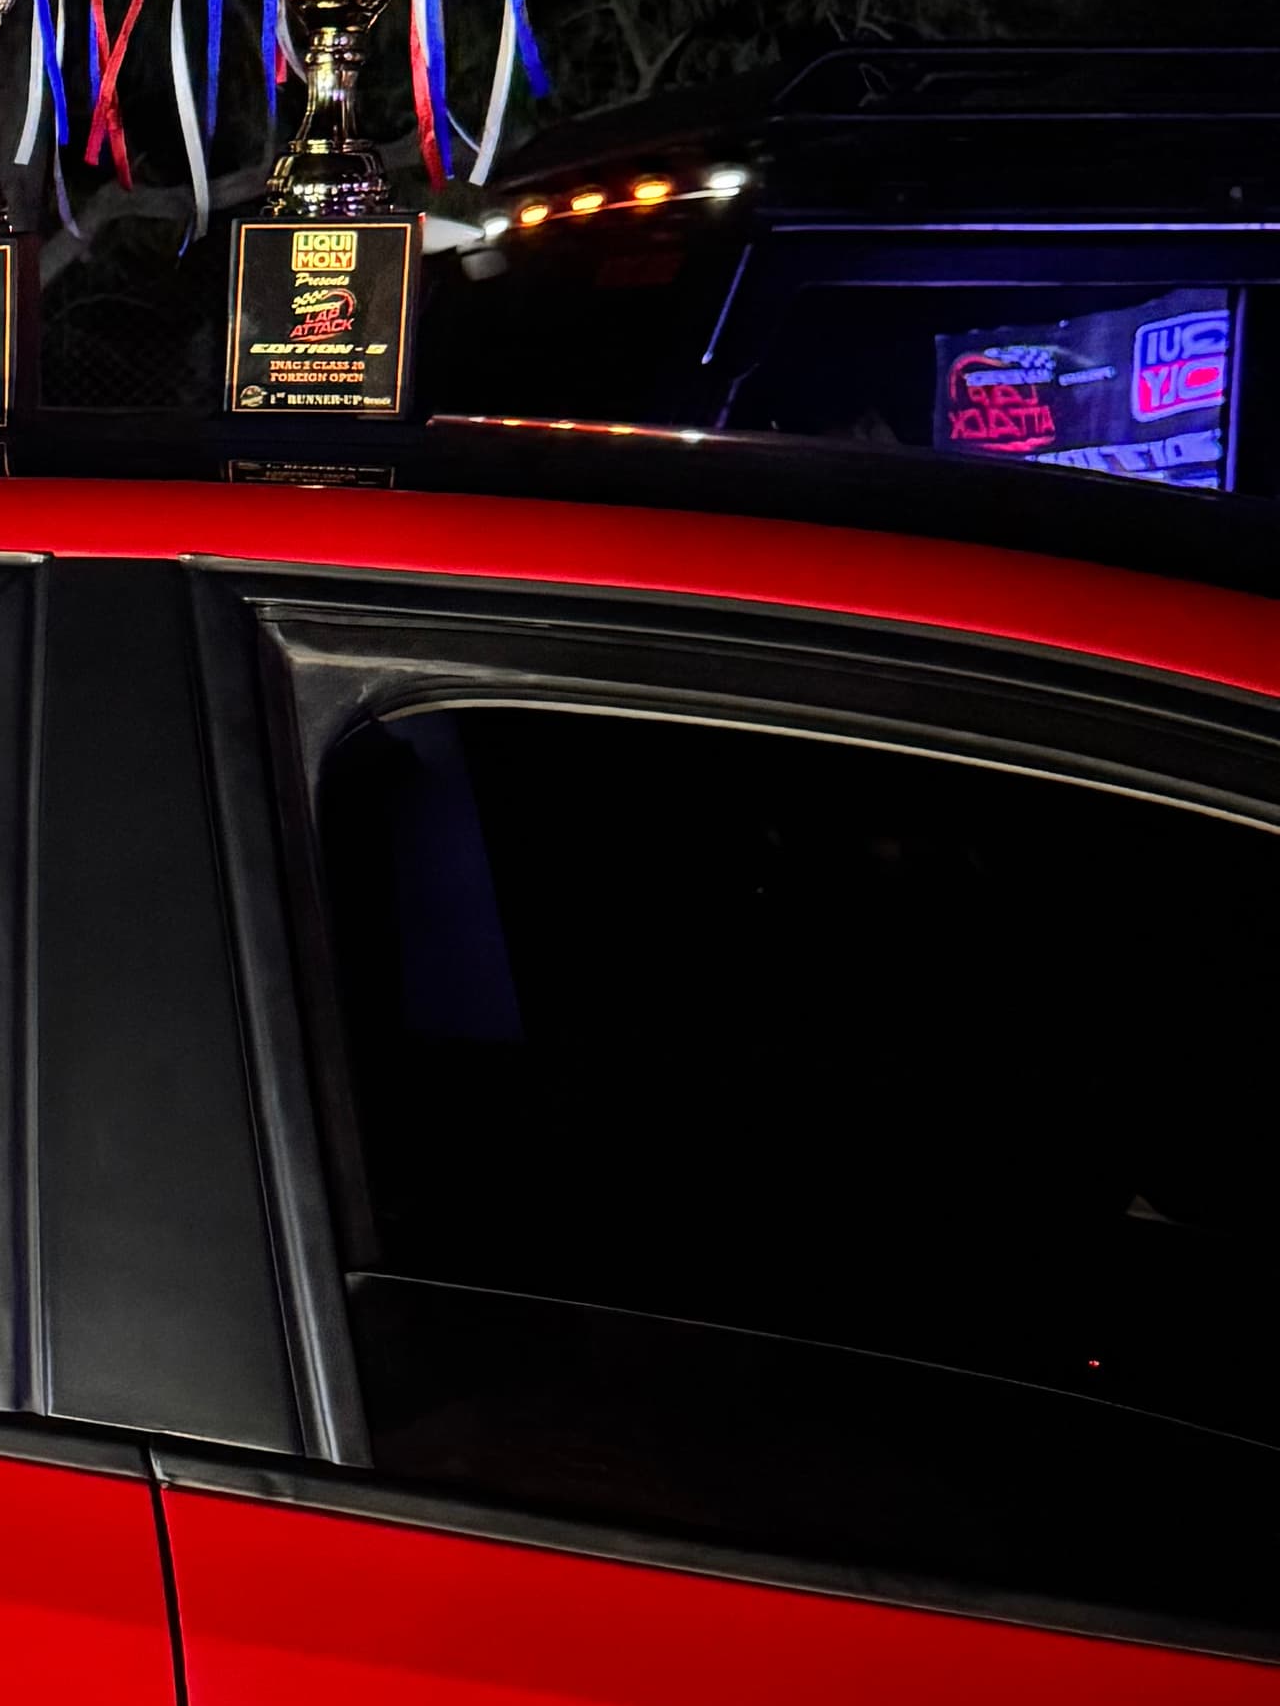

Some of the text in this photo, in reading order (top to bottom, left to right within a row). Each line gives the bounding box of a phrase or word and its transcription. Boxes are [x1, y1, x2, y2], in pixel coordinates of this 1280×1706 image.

[297, 234, 353, 251] LIQUI
[297, 251, 353, 268] MOLY
[295, 272, 350, 287] Presents
[305, 307, 340, 324] LAP
[290, 318, 355, 337] ATTACK
[312, 360, 350, 370] CLASS
[270, 372, 364, 382] FOREIGN OPEN
